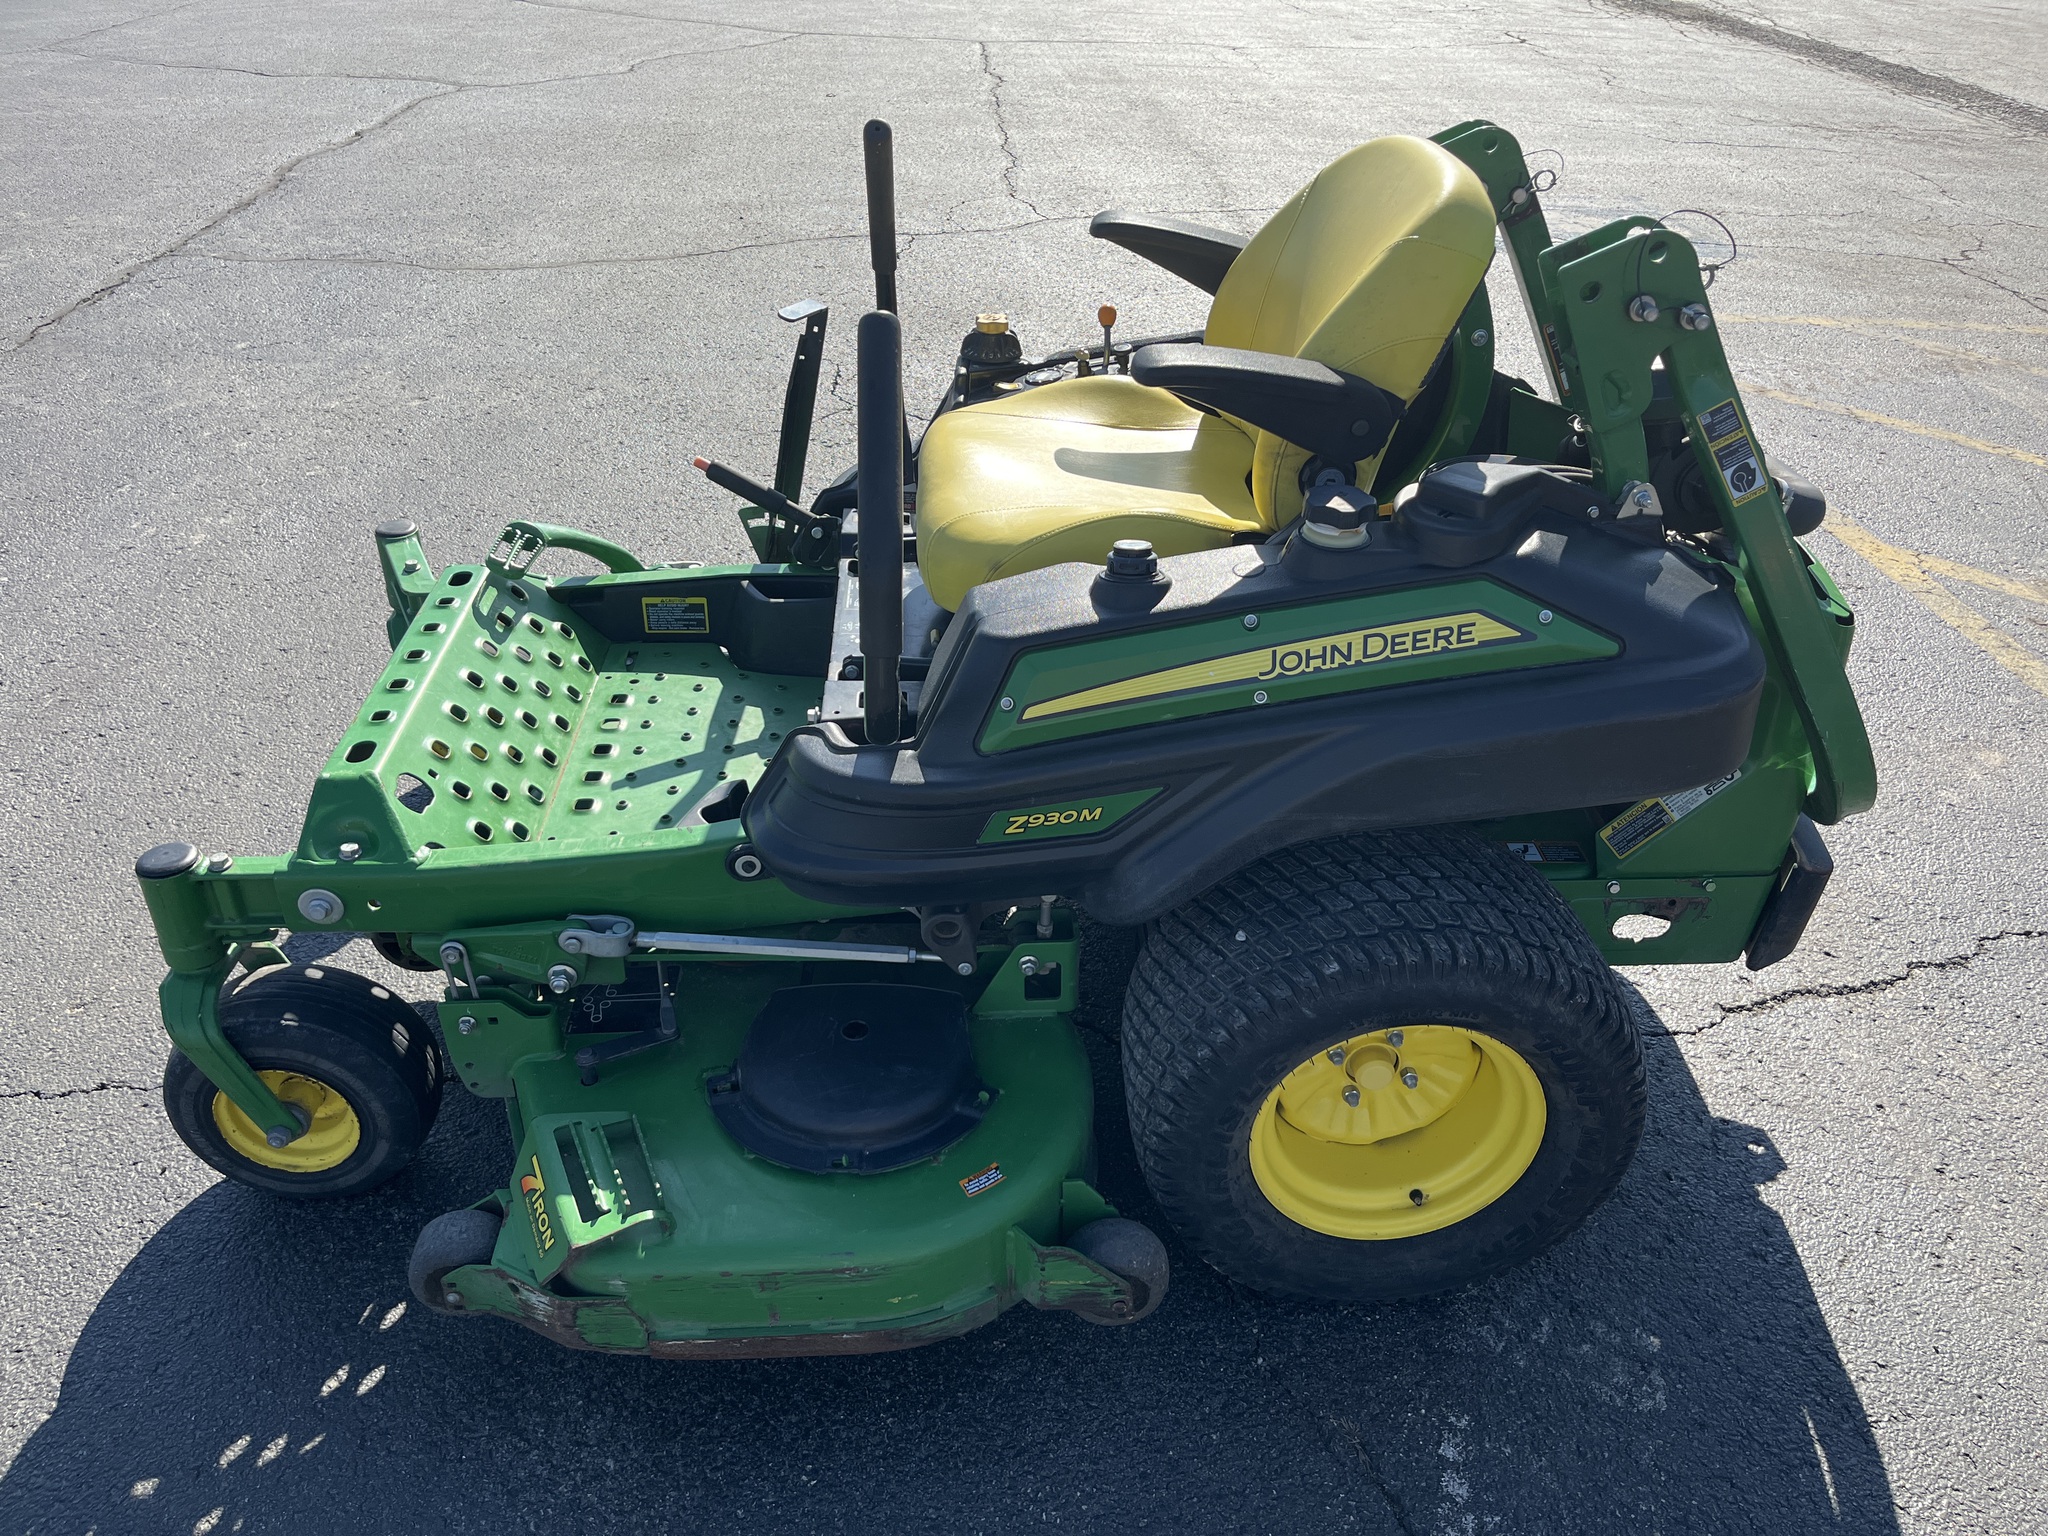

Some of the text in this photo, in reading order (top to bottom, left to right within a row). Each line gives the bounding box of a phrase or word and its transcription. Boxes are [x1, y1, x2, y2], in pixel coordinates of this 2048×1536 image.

[1257, 620, 1478, 679] JOHN DEERE
[1003, 805, 1104, 835] Z930M
[1616, 802, 1648, 828] ATENCION
